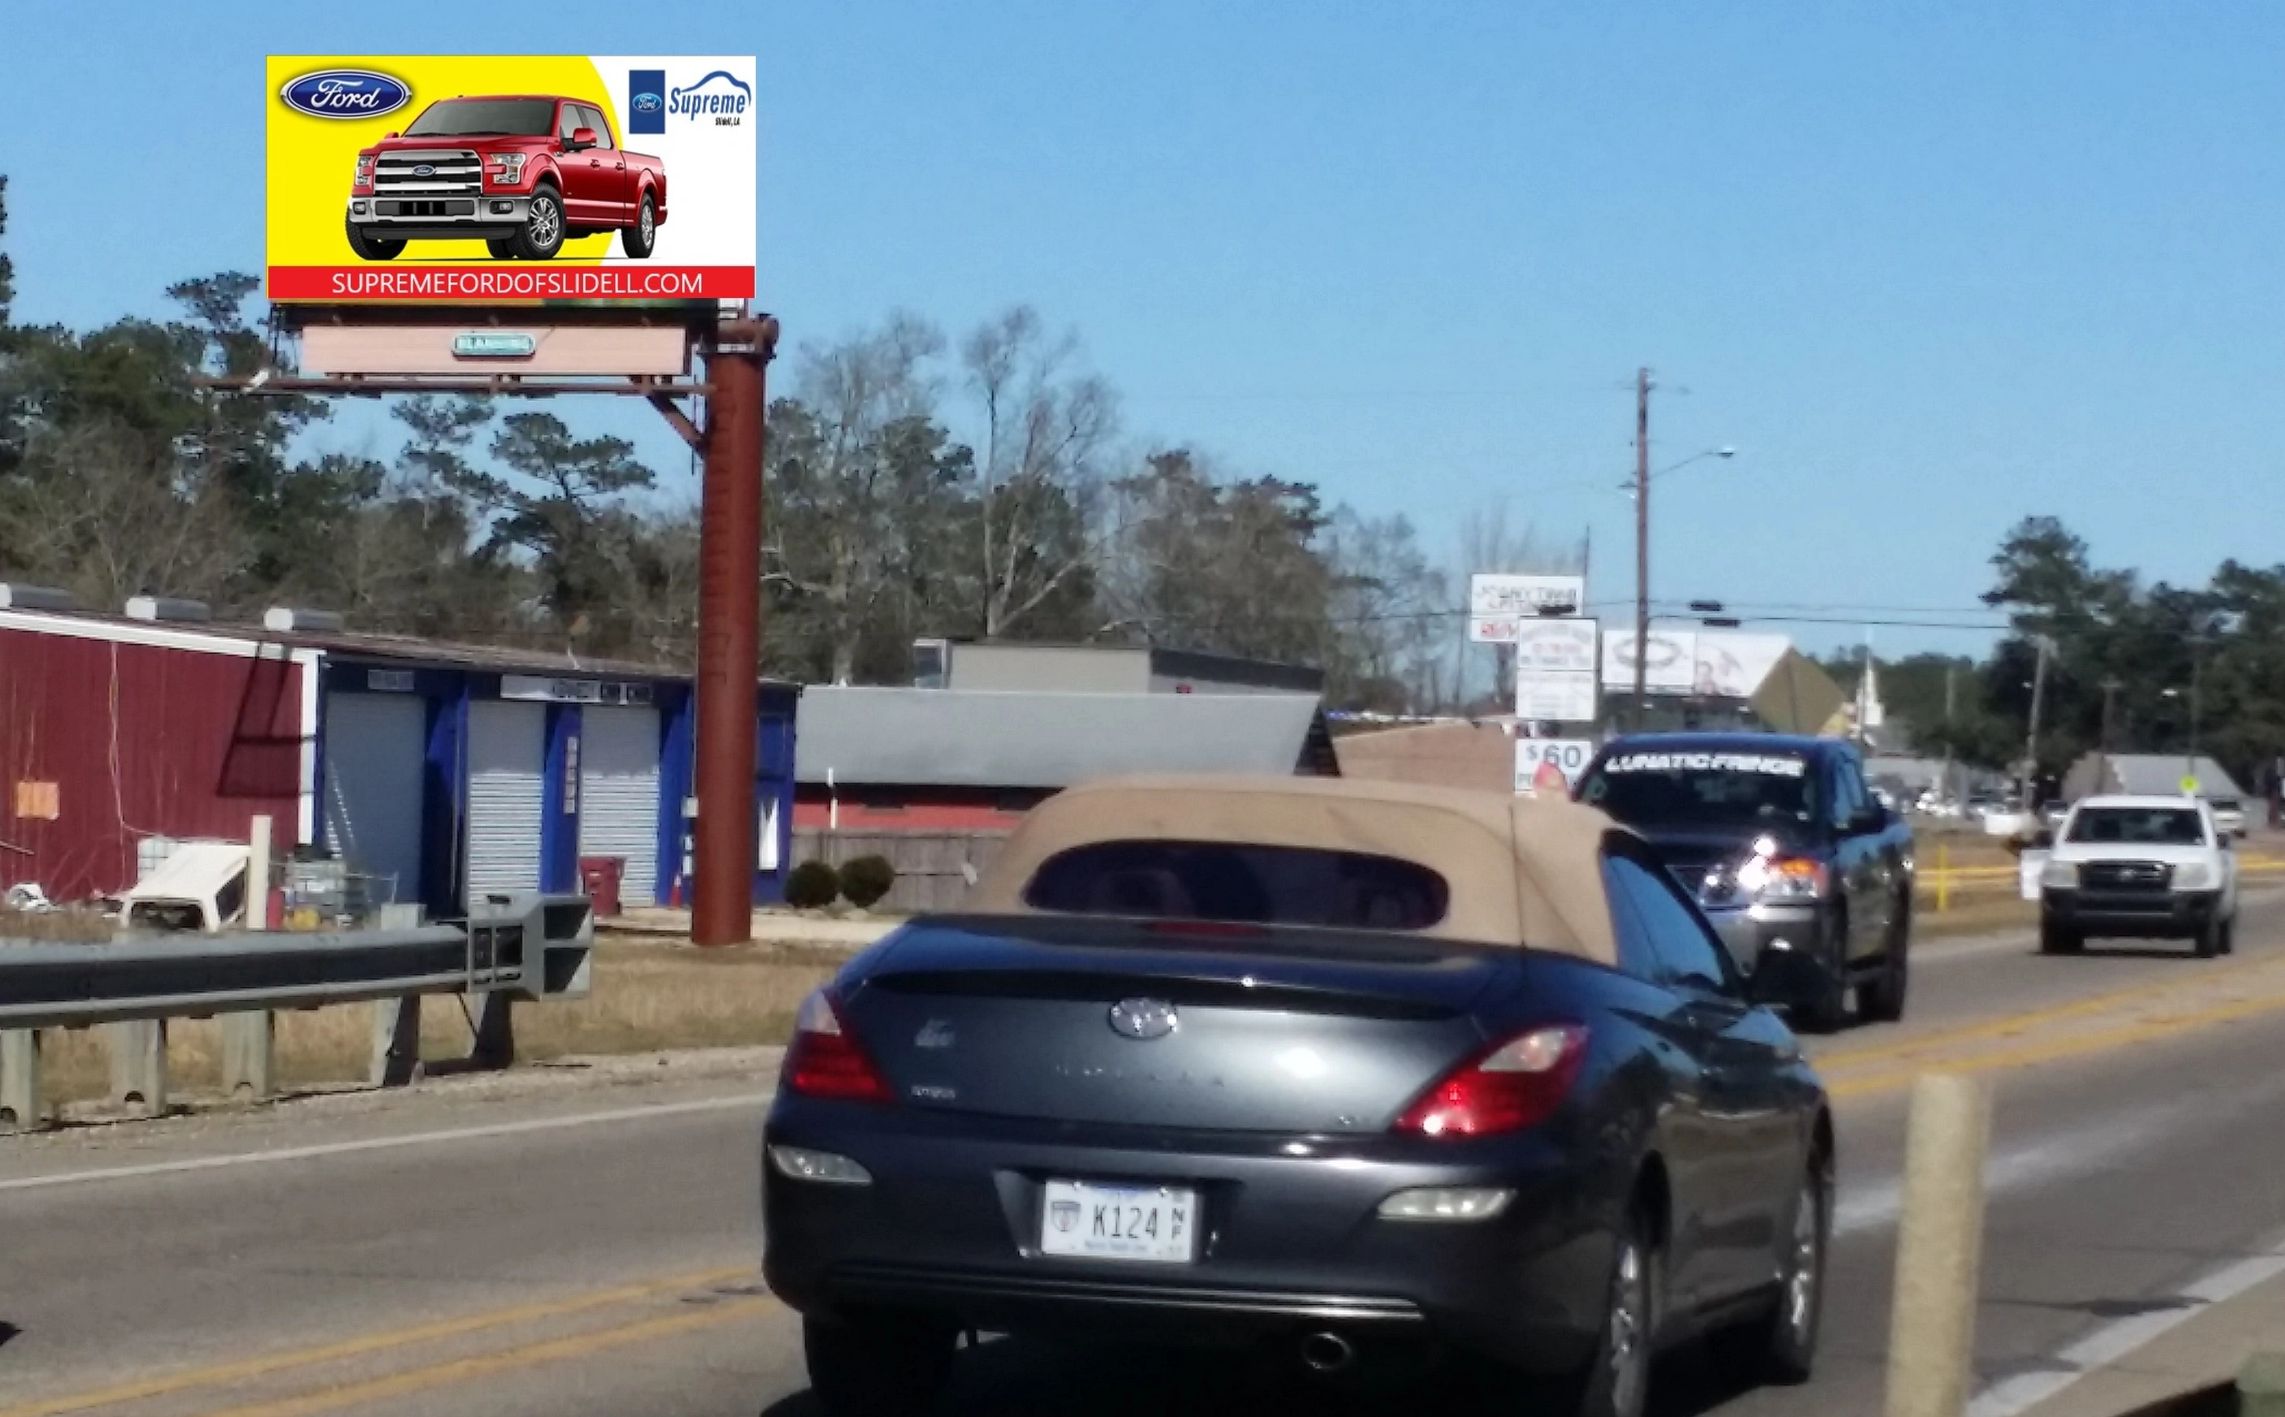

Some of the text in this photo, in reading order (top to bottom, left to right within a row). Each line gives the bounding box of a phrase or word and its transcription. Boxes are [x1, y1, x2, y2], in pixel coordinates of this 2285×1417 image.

[311, 79, 381, 108] Ford
[638, 95, 657, 109] Ford
[669, 87, 746, 121] Supreme
[332, 273, 703, 295] SUPREMEFORDOFSLIDELL.COM
[1093, 1204, 1158, 1240] K124
